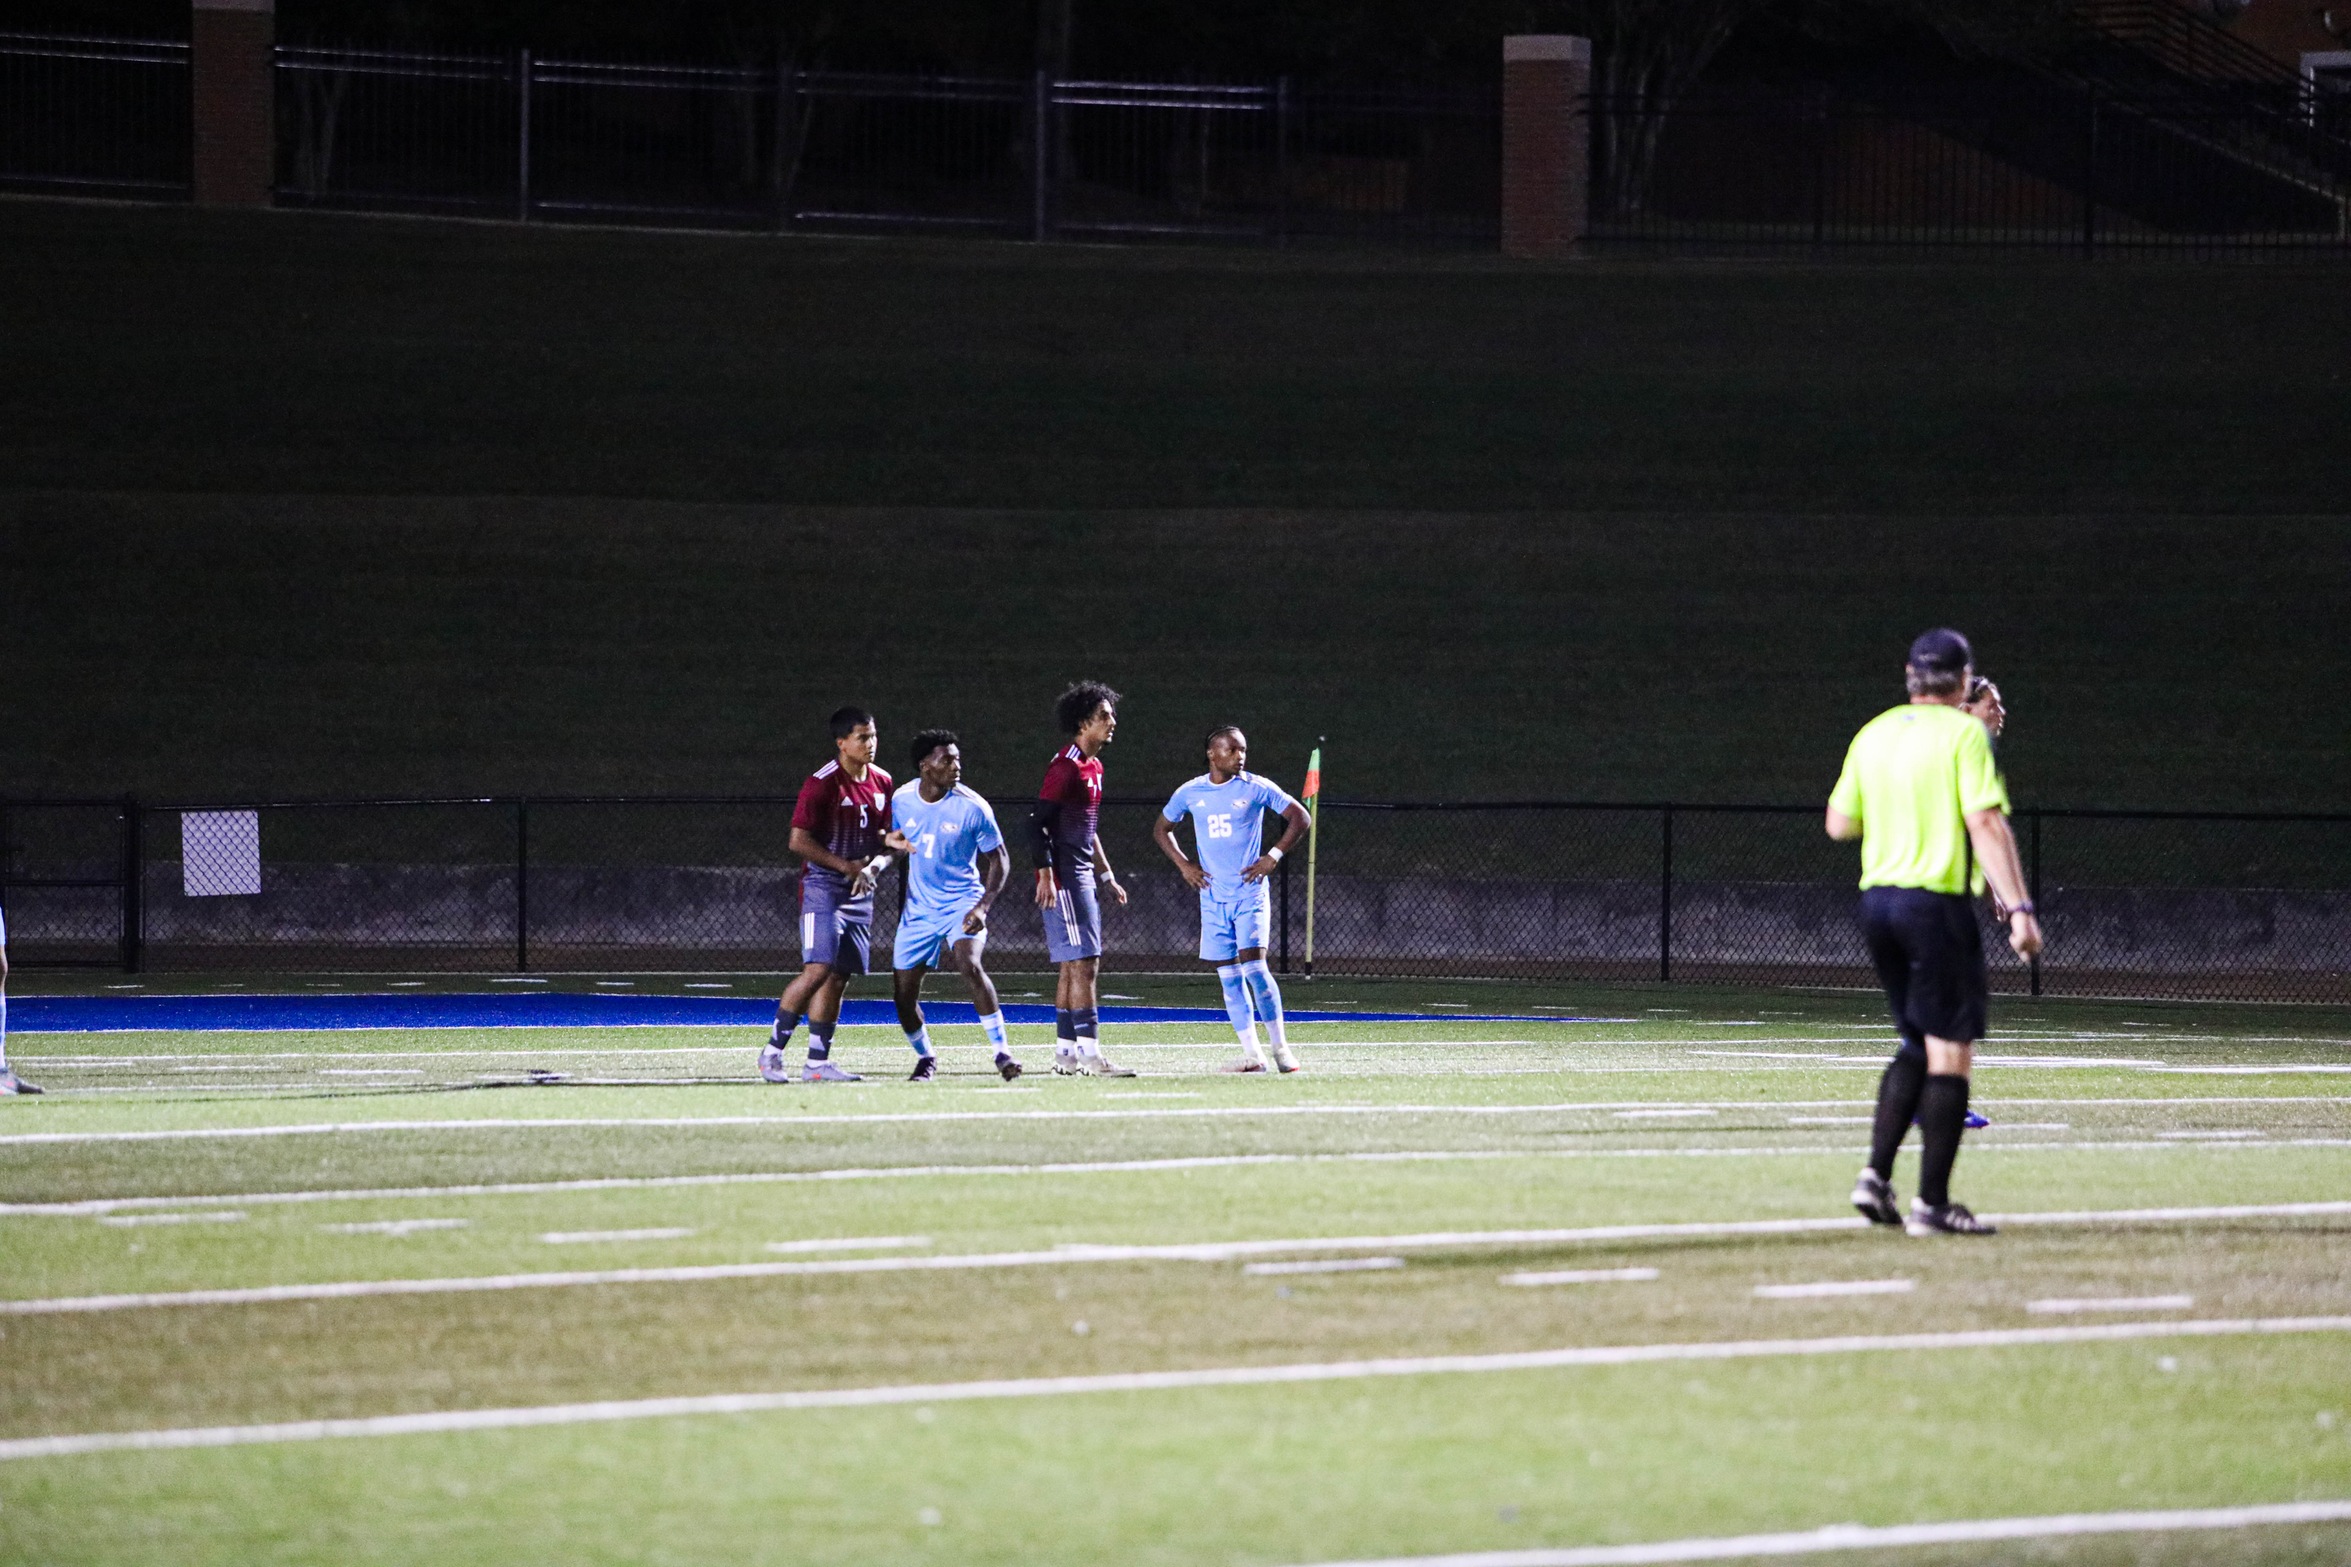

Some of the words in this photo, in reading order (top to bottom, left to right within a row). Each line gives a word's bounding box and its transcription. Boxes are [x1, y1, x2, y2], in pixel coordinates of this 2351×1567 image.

[860, 804, 869, 829] 5
[1207, 813, 1233, 839] 25
[922, 833, 936, 859] 7
